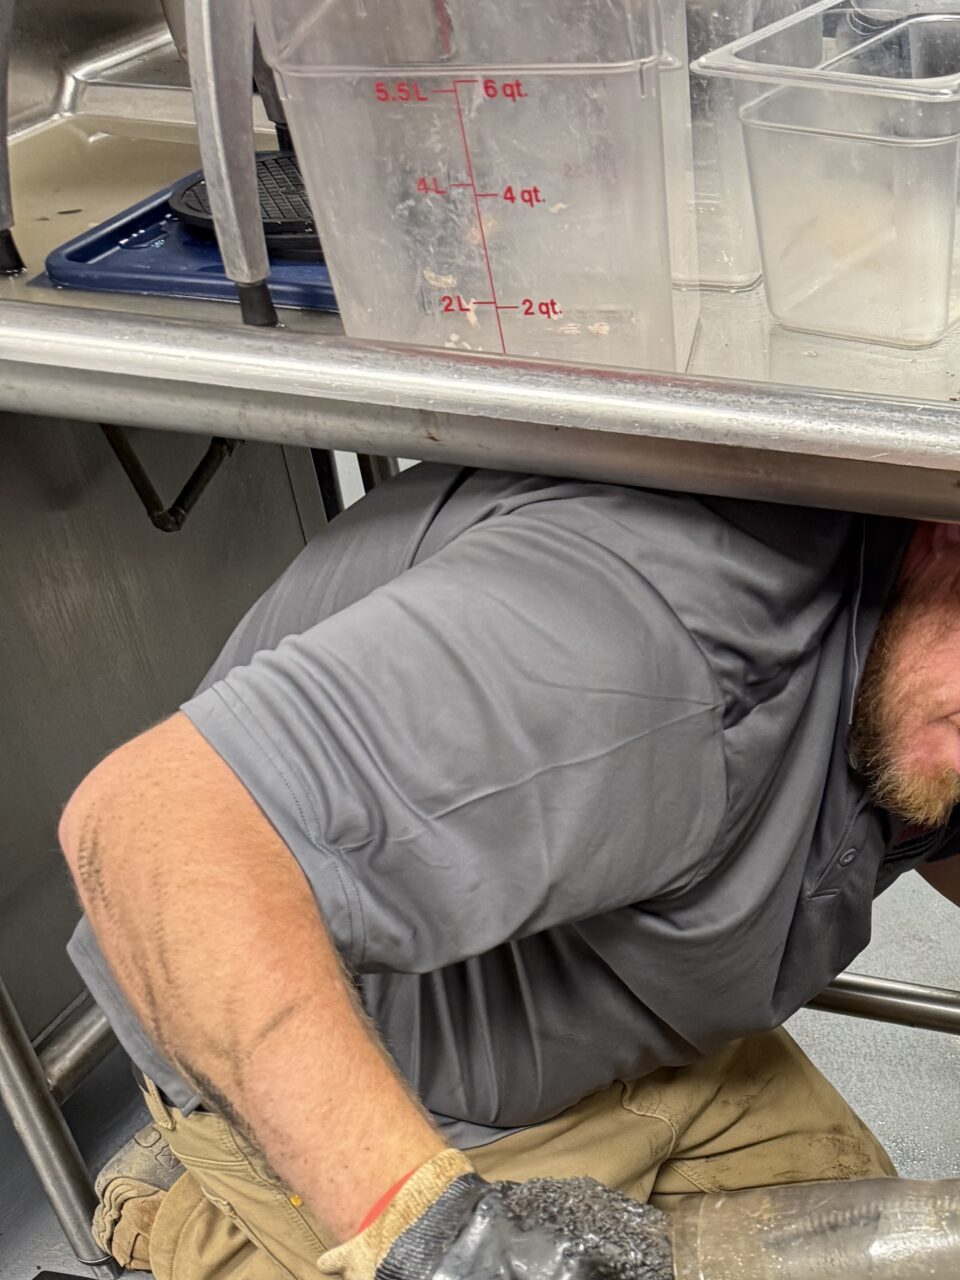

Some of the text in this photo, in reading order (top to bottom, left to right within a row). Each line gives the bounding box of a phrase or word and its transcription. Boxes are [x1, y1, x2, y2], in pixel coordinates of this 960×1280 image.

[484, 79, 498, 98] 6
[503, 185, 516, 203] 4
[522, 298, 535, 315] 2
